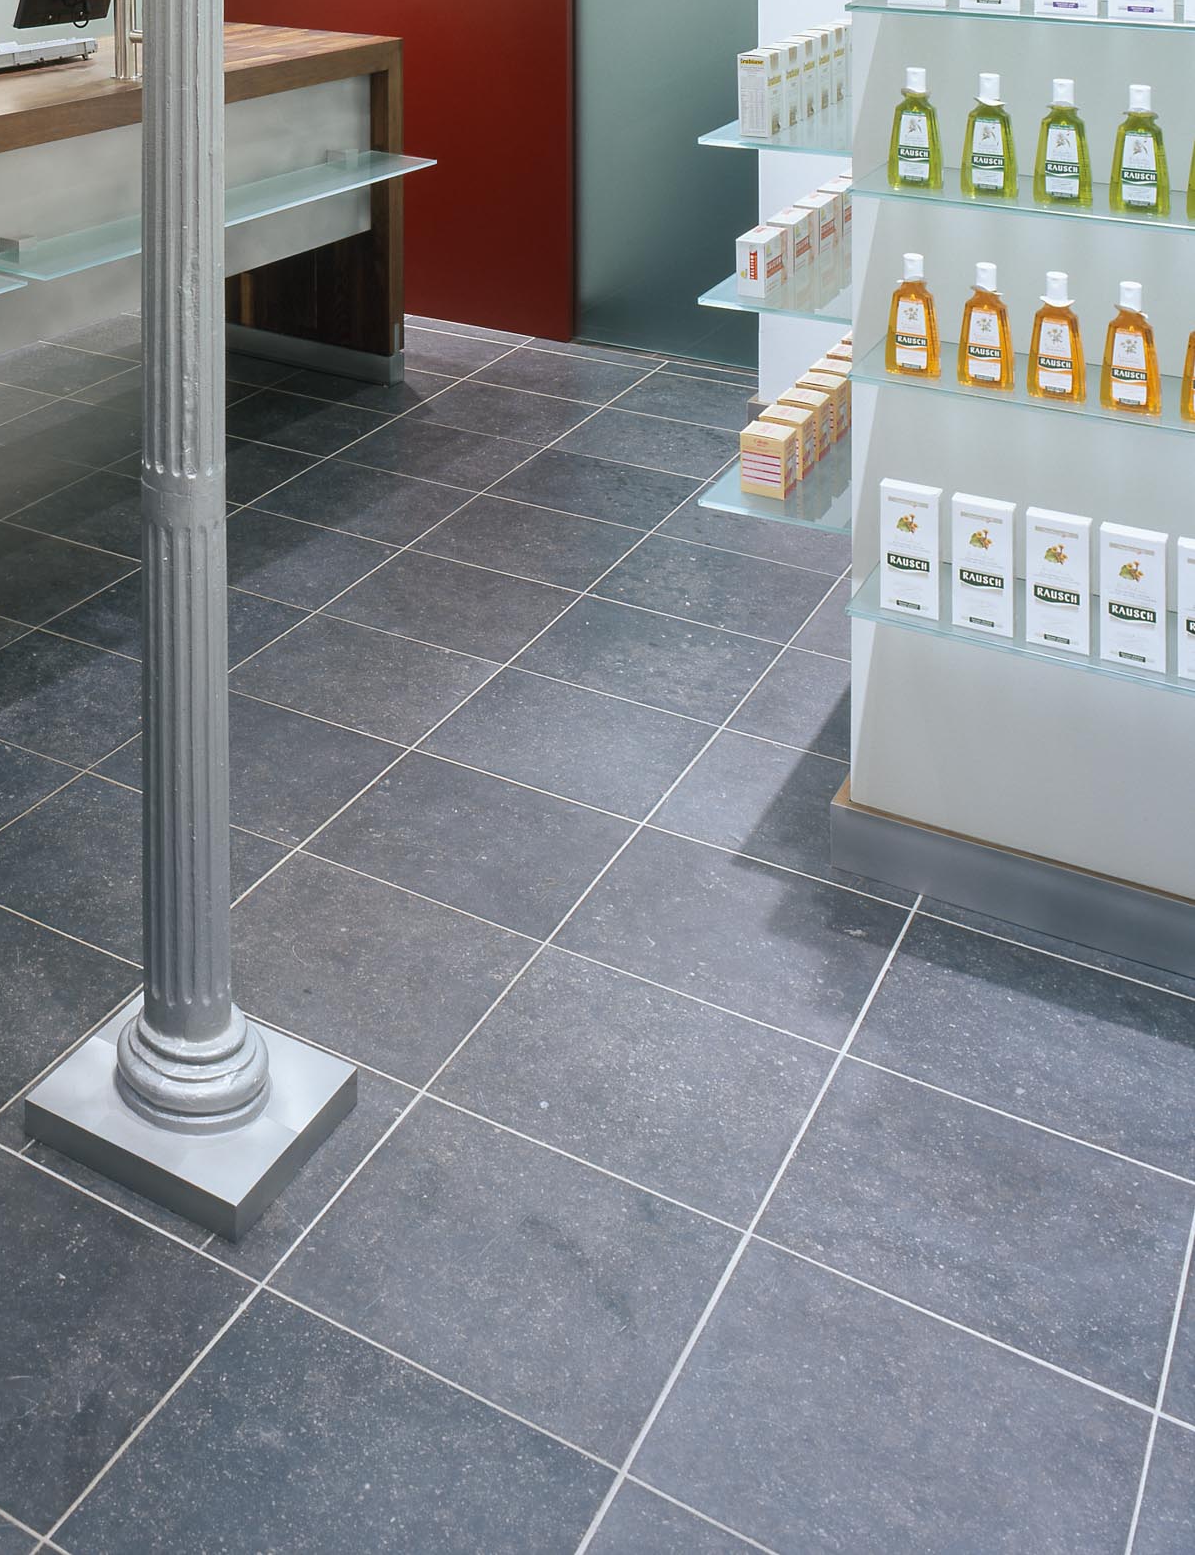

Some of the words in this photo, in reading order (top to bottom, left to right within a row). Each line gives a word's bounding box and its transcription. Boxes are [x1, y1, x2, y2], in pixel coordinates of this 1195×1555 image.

[900, 148, 929, 158] RAUSCH
[973, 156, 1003, 165] RAUSCH
[1047, 163, 1079, 173] RAUSCH
[1123, 171, 1156, 181] RAUSCH
[897, 335, 927, 345] RAUSCH
[970, 346, 1000, 357] RAUSCH
[1040, 358, 1072, 369] RAUSCH
[1113, 369, 1146, 380] RAUSCH
[889, 555, 928, 571] RAUSCH
[962, 571, 1002, 587] RAUSCH
[1036, 587, 1078, 604] RAUSCH
[1111, 604, 1154, 622] RAUSCH
